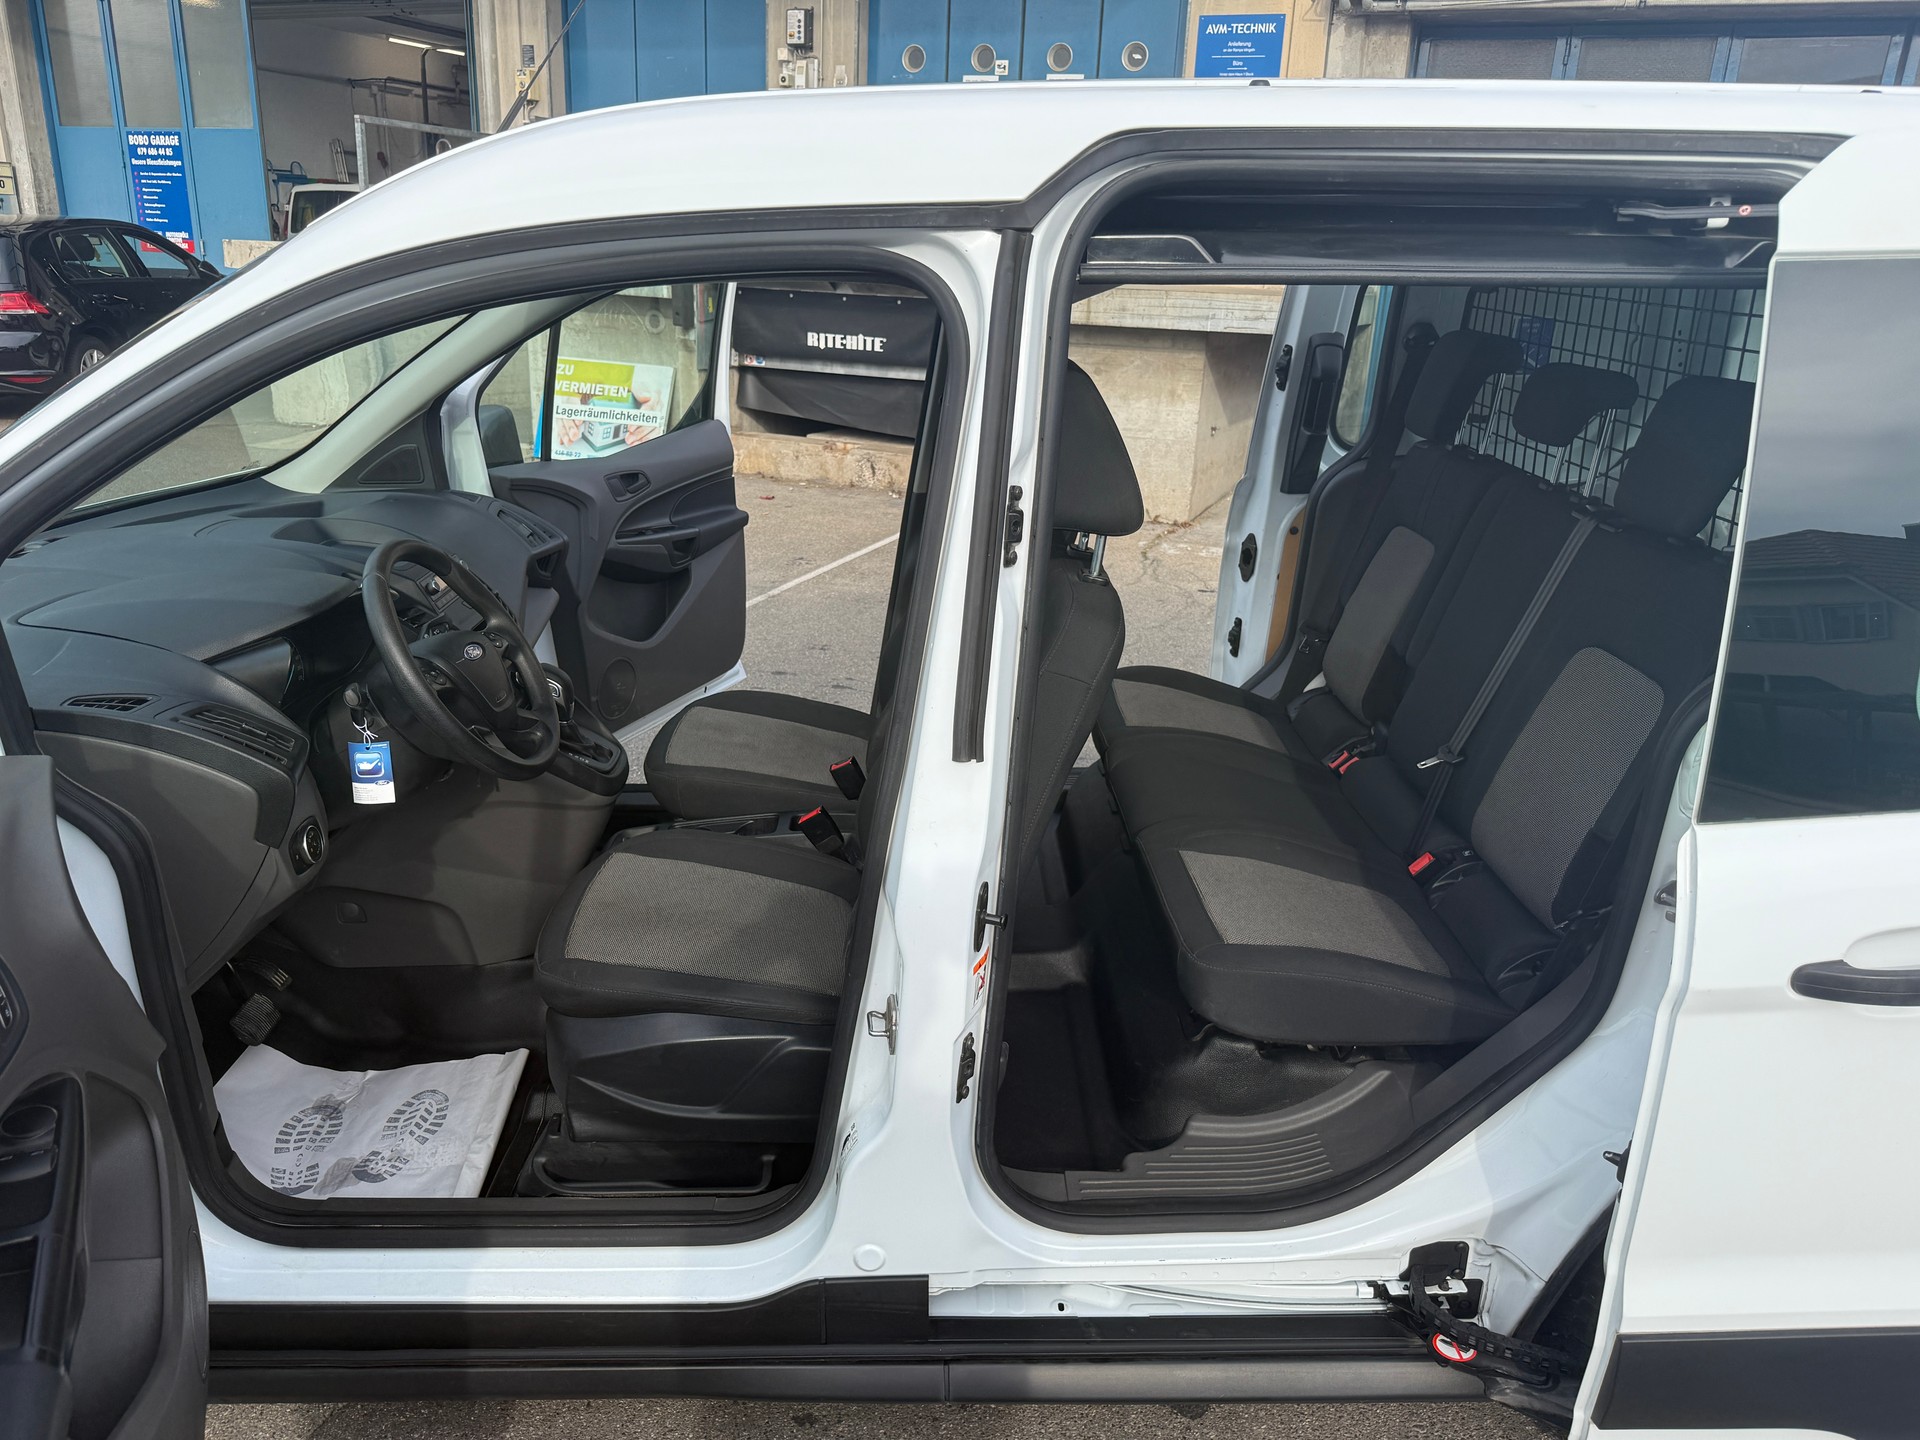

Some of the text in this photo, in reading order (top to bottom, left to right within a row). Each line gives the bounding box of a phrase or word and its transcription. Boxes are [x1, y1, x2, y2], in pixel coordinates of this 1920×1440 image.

[1206, 23, 1276, 34] AVM-TECHNIK
[128, 135, 179, 146] BOBO GARAGE
[137, 147, 147, 155] 079
[556, 364, 574, 376] ZU
[555, 380, 628, 398] VERMIETEN
[555, 405, 658, 424] Lagerräumlichkeiten
